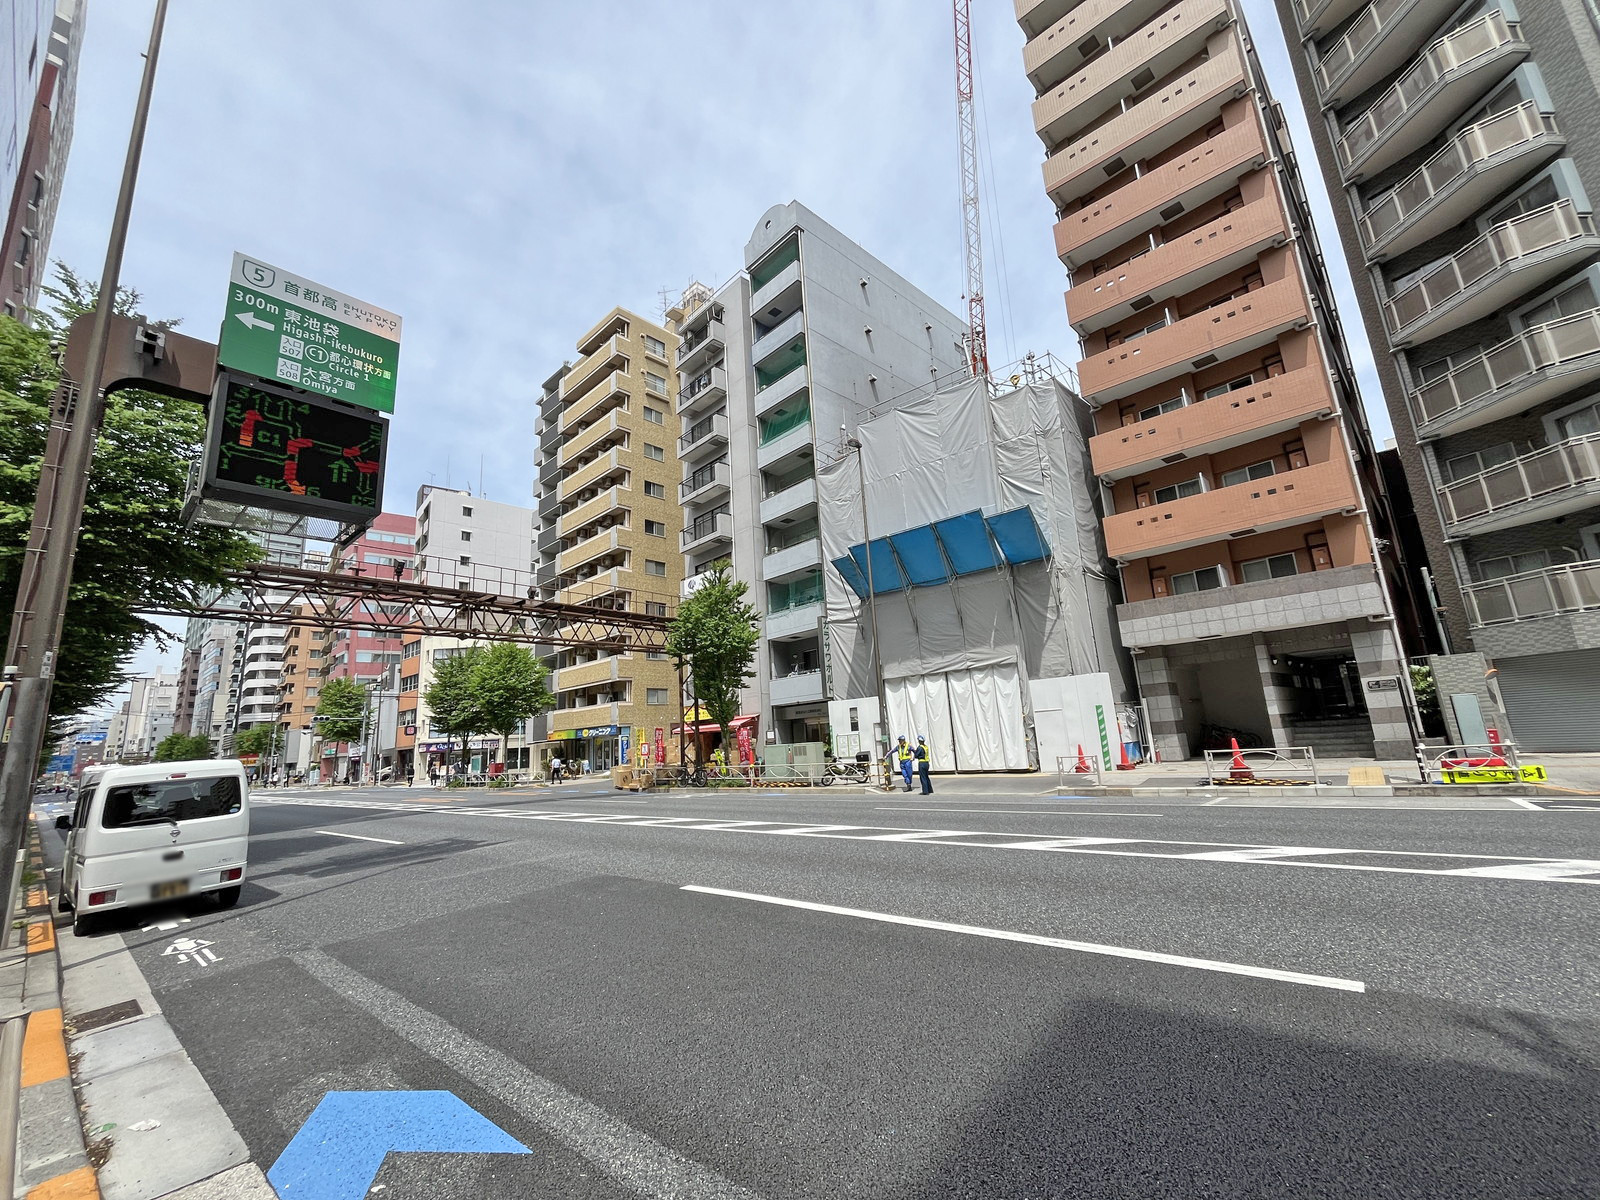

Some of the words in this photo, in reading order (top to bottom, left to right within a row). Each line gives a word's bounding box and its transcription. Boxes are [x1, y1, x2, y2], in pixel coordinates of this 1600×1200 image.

[253, 268, 265, 282] 5
[234, 290, 279, 315] 300m
[284, 281, 338, 311] 首都高
[283, 308, 340, 339] 東池袋
[343, 303, 397, 327] SHUTOKO
[282, 346, 301, 357] S07
[283, 322, 383, 364] Higashi-ikebukuro
[284, 337, 302, 349] 入口
[309, 347, 323, 360] C1
[279, 369, 298, 380] S08
[281, 361, 299, 372] 入口
[328, 362, 360, 378] Circle
[363, 373, 370, 381] 1
[329, 351, 391, 380] 都心環状方面
[302, 377, 338, 394] Omiya
[303, 366, 356, 391] 大宮方面
[257, 429, 281, 447] C1
